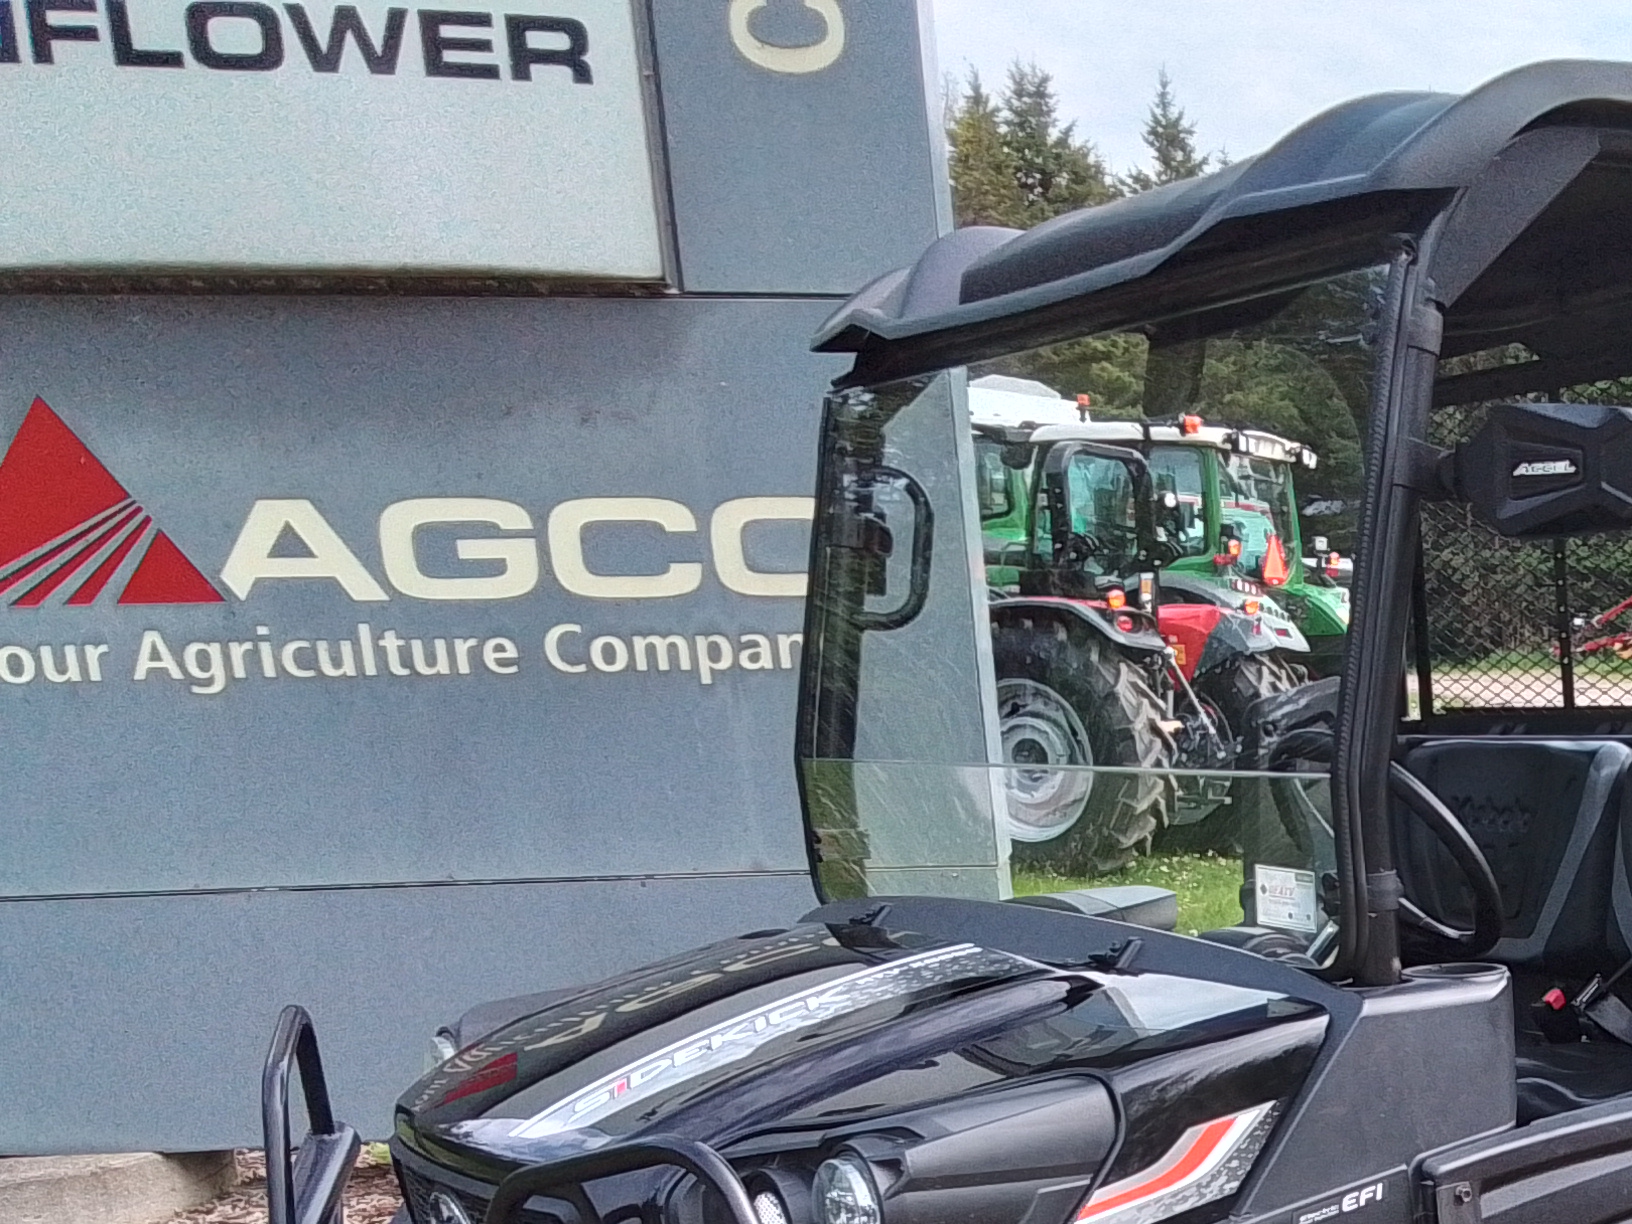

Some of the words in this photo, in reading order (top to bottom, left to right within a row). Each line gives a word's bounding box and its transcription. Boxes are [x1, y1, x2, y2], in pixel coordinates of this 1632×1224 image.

[0, 0, 594, 85] FLOWER
[0, 644, 109, 684] our
[133, 622, 520, 694] Agriculture
[544, 622, 805, 686] Compan
[568, 984, 850, 1122] SIDEKICK
[1341, 1182, 1383, 1212] EFI
